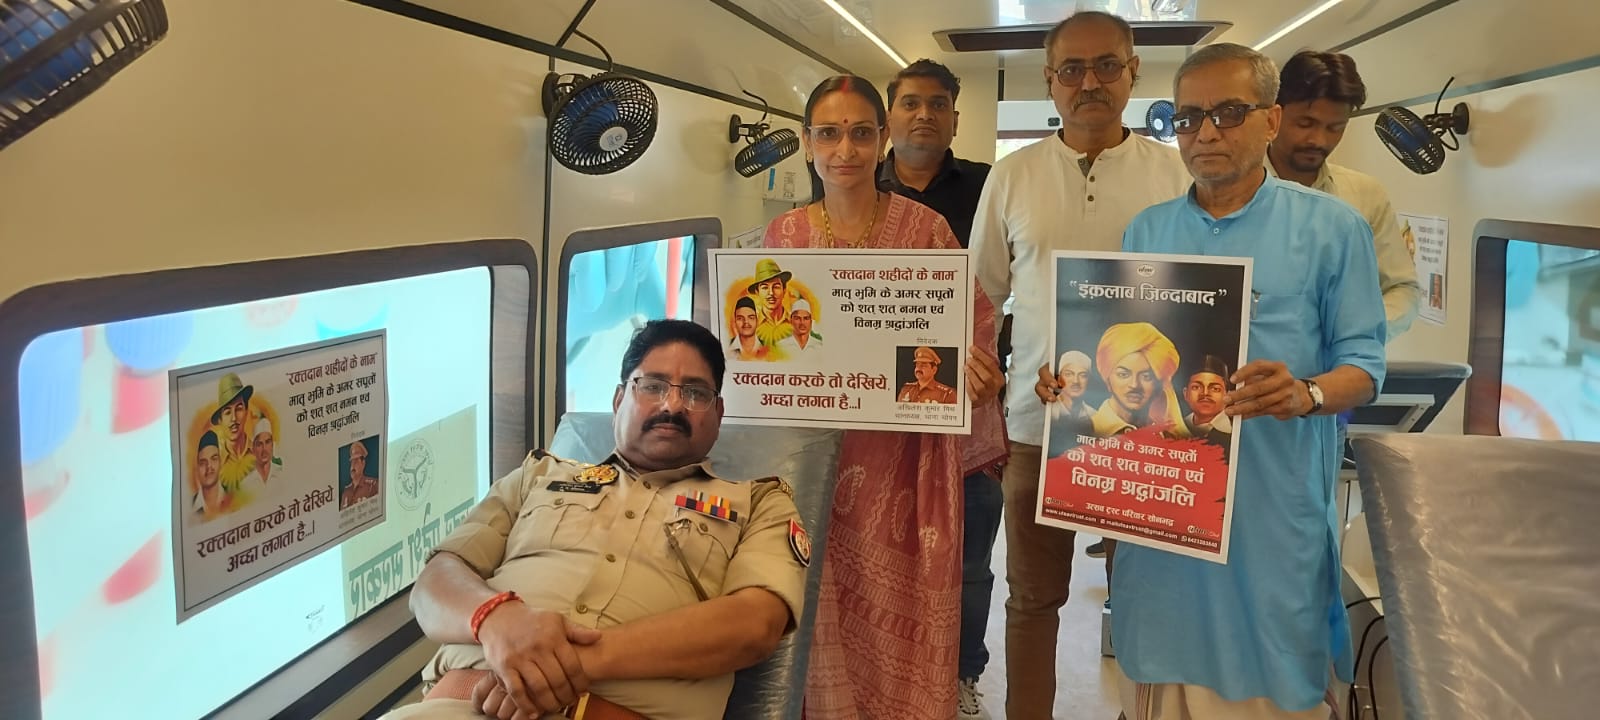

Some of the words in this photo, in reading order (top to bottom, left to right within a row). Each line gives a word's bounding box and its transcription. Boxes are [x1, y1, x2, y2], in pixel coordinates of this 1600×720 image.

[879, 267, 914, 281] शहीदों
[916, 267, 928, 280] के
[880, 287, 891, 298] के
[895, 290, 922, 299] अमर
[925, 288, 954, 301] सपूतों
[840, 302, 854, 313] को
[879, 304, 896, 315] शत्
[900, 305, 926, 314] नमन
[854, 317, 881, 329] विनम्र
[324, 357, 348, 375] शहीदों
[350, 354, 358, 369] के
[326, 383, 334, 396] के
[336, 380, 353, 393] अमर
[732, 372, 785, 386] रक्तदान
[789, 371, 826, 387] करके
[829, 372, 843, 389] तो
[296, 409, 308, 422] को
[340, 395, 357, 409] नमन
[760, 393, 794, 407] अच्छा
[797, 395, 835, 408] लगता
[308, 422, 328, 438] विनम्र
[1123, 440, 1135, 452] के
[1138, 444, 1165, 457] अमर
[1168, 449, 1198, 464] सपूतों
[1067, 448, 1085, 463] को
[1090, 453, 1113, 470] शत्
[1117, 458, 1140, 475] शत्
[1144, 462, 1181, 480] नमन
[1185, 468, 1205, 484] एवं
[1072, 466, 1117, 494] विनम्र
[1121, 480, 1196, 507] श्रद्धांजलि
[196, 522, 251, 558] रक्तदान
[254, 505, 286, 533] करके
[288, 499, 300, 520] तो
[227, 545, 259, 573] अच्छा
[261, 529, 294, 557] लगता
